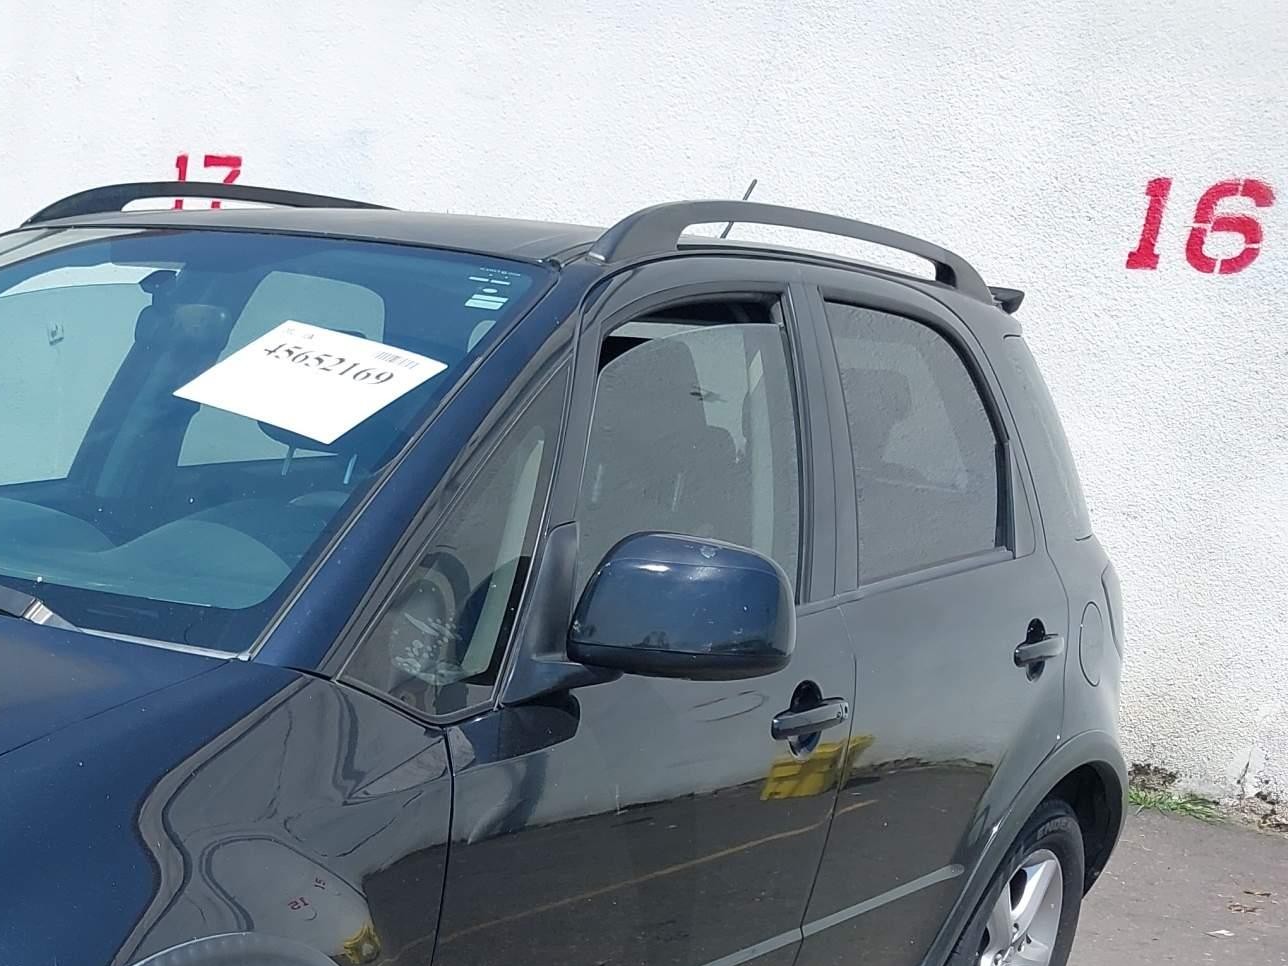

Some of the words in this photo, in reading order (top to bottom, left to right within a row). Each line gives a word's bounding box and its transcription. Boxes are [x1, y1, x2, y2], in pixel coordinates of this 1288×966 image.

[172, 154, 242, 210] 17
[1125, 177, 1276, 274] 16
[263, 343, 395, 385] 45652169
